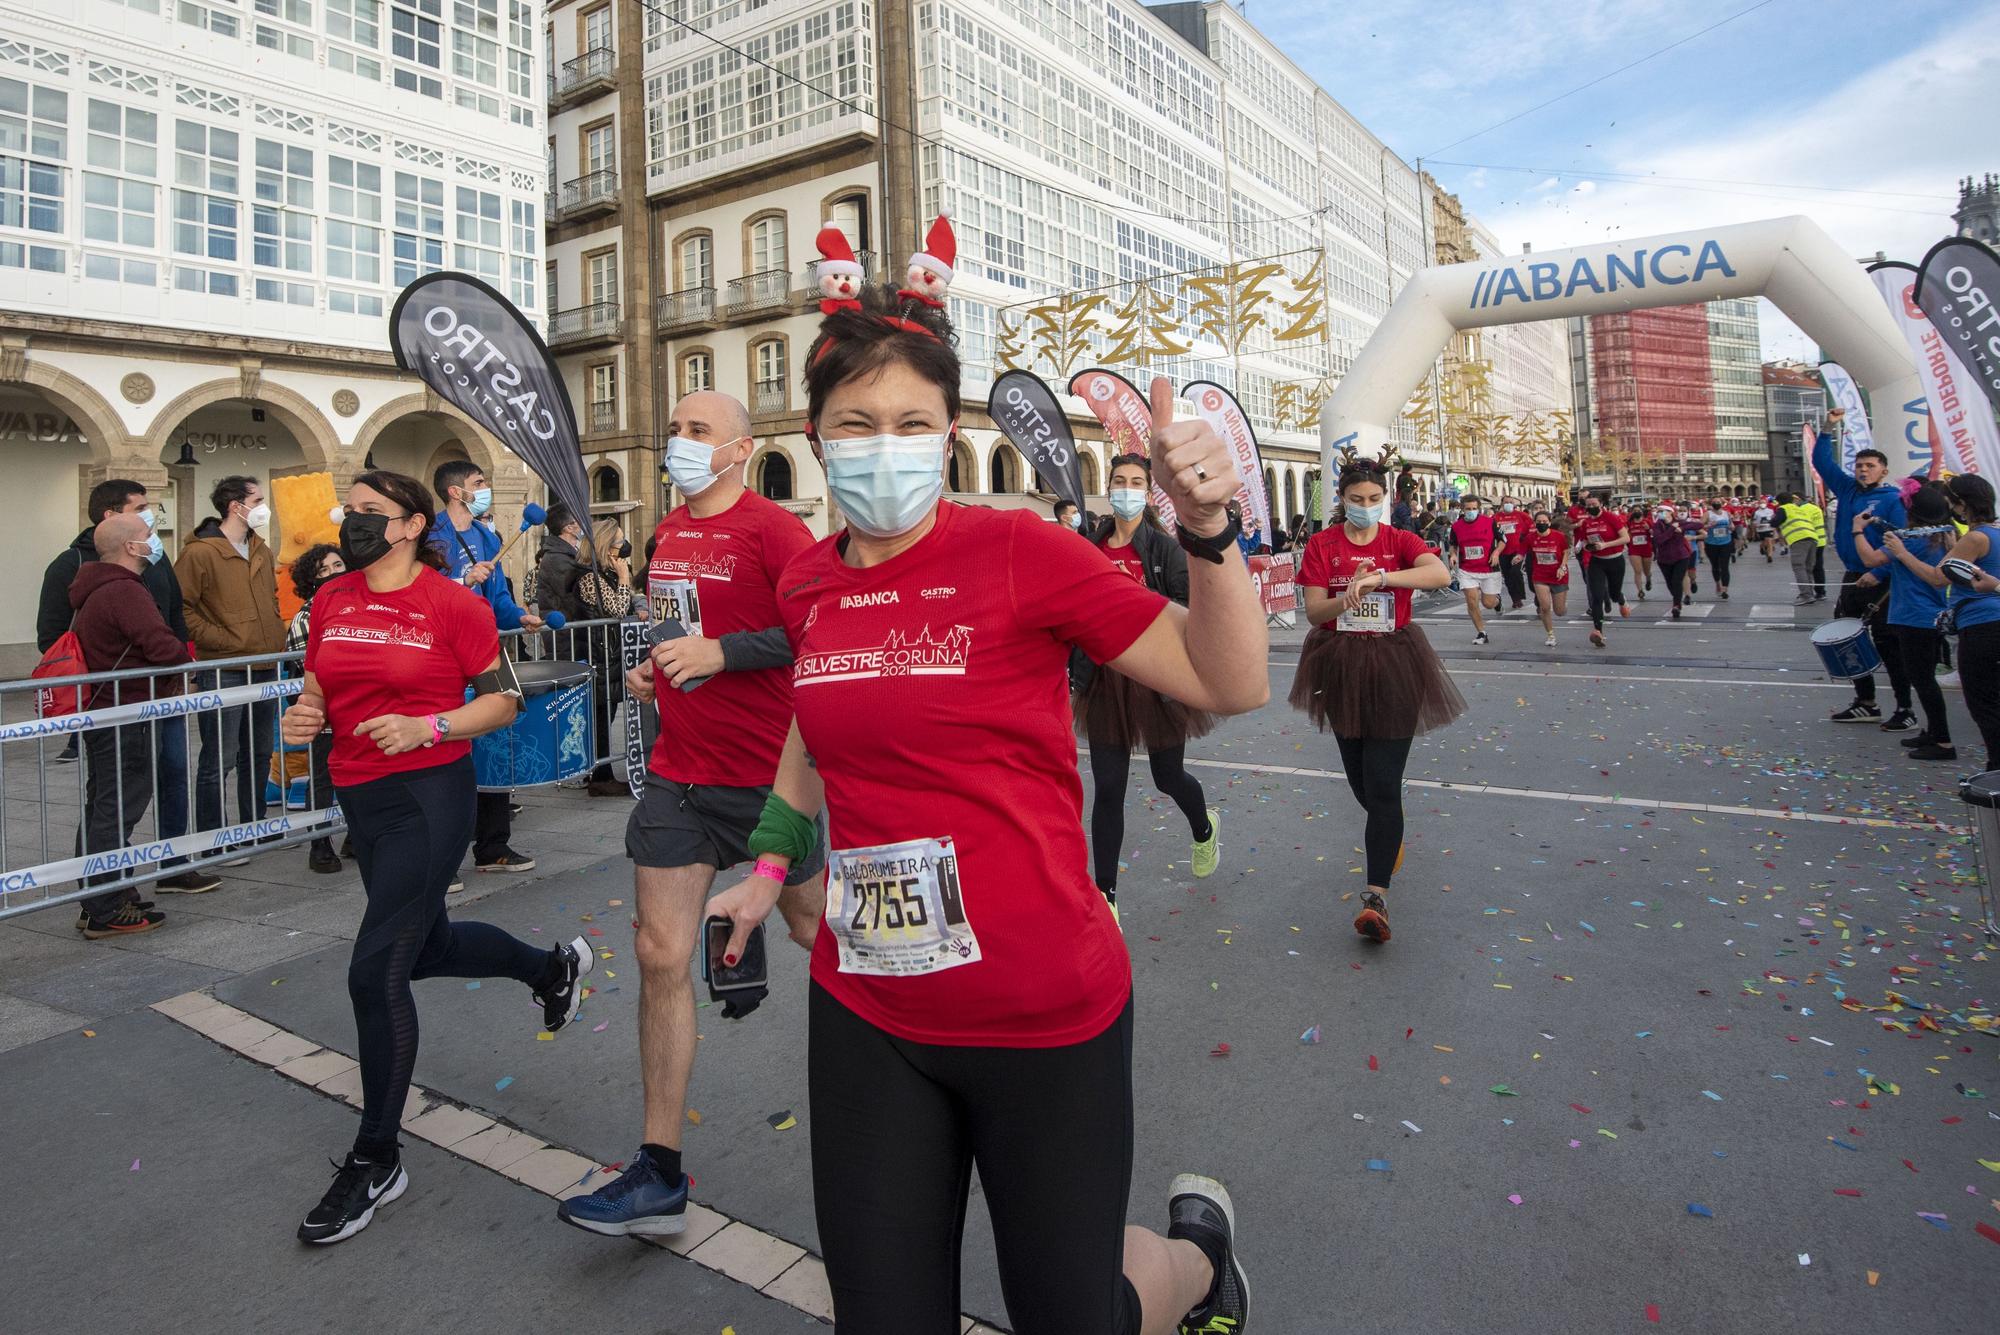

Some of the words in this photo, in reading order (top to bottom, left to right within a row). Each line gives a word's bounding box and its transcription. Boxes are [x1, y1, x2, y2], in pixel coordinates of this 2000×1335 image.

[921, 587, 956, 597] CASTRO
[882, 665, 910, 677] 2021
[842, 856, 931, 881] GALDRUMEIRA
[851, 878, 928, 930] 2755
